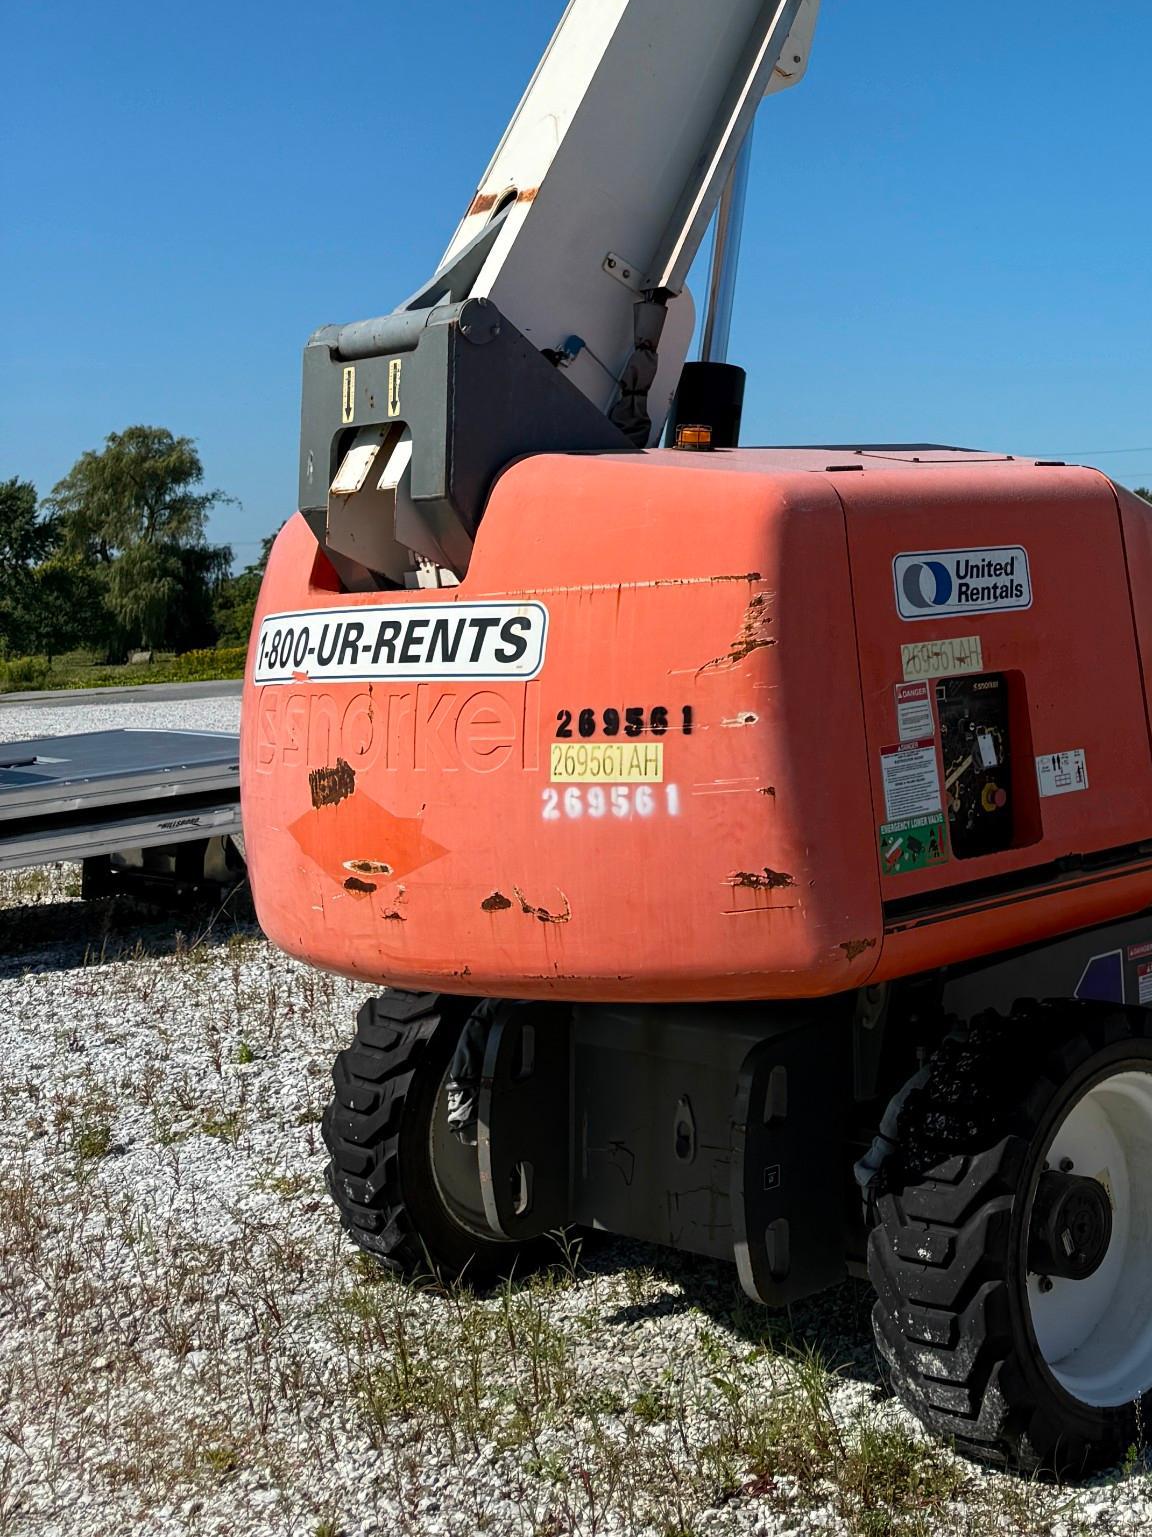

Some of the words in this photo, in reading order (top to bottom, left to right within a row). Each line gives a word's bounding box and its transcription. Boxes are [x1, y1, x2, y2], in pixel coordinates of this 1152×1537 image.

[955, 555, 1015, 580] United
[957, 578, 1024, 603] Rentals
[258, 616, 532, 671] 1-800-UR-RENTS
[902, 637, 980, 675] 269561AH
[902, 687, 927, 698] DANGER
[555, 705, 693, 738] 269561
[552, 744, 660, 777] 269561AH
[541, 783, 680, 821] 269561
